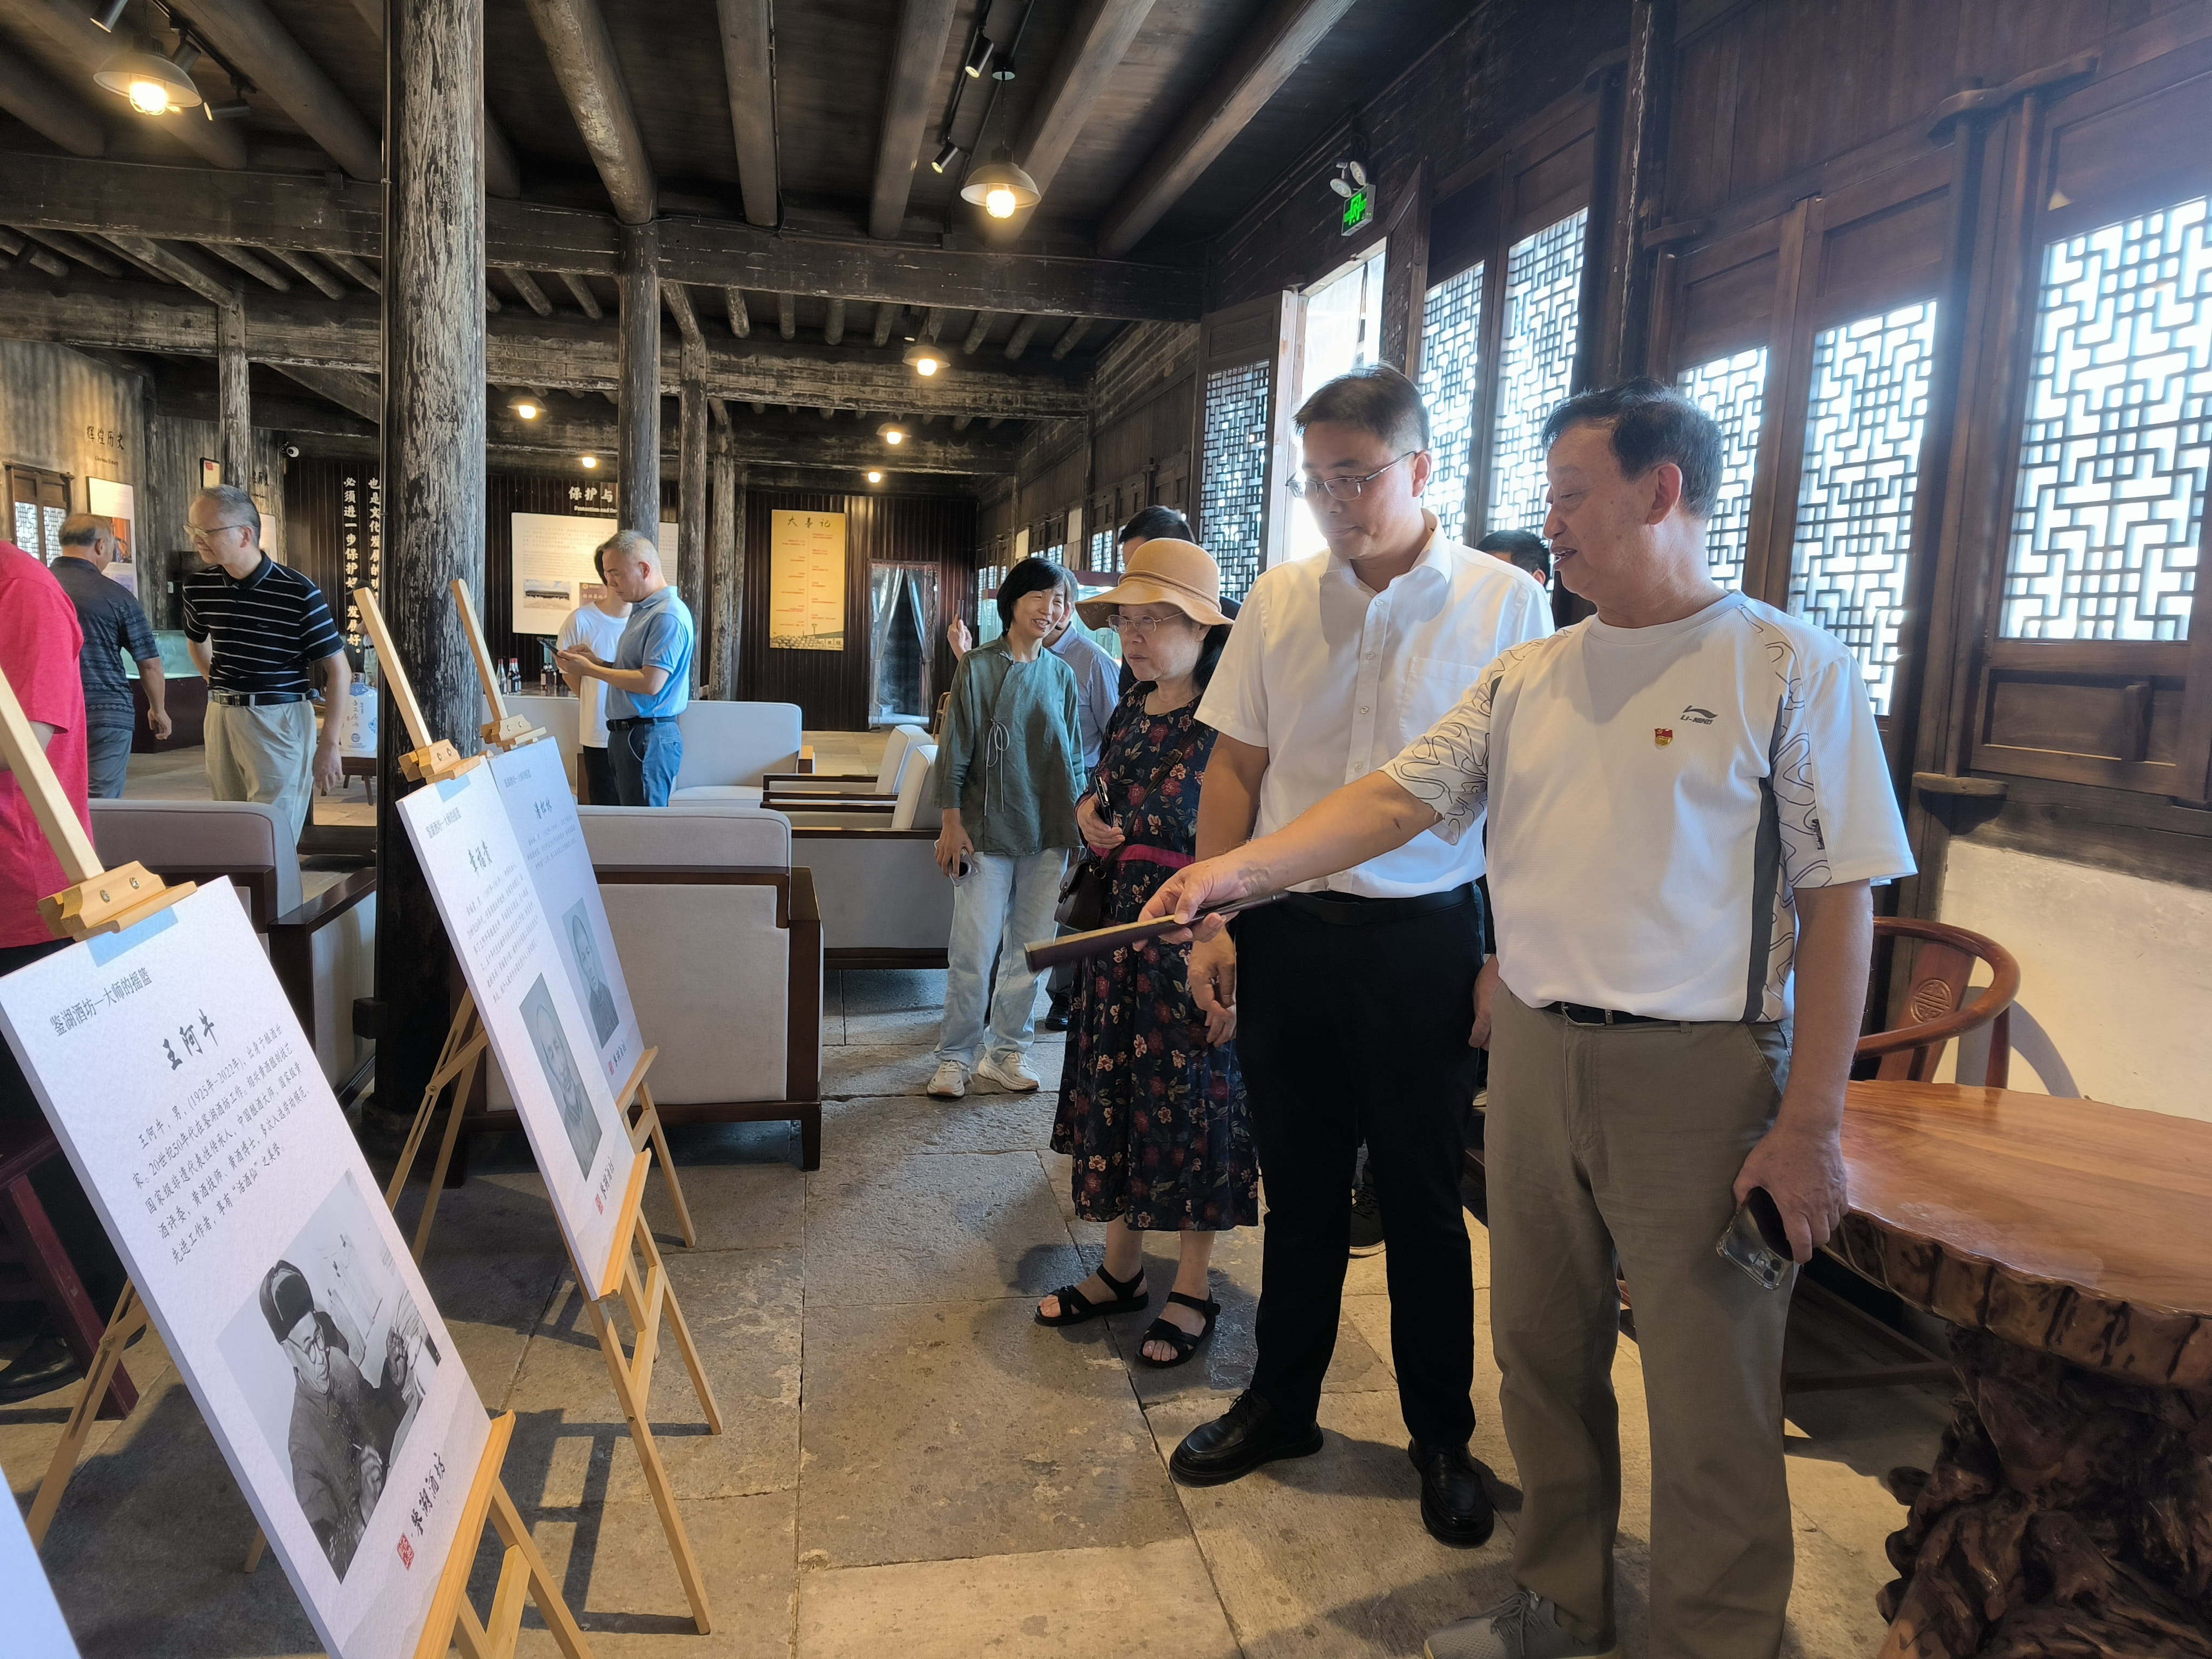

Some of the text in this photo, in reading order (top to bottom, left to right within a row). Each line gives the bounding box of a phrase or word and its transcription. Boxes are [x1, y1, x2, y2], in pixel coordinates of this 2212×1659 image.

[787, 515, 831, 529] 大事记
[163, 1008, 218, 1070] 王阿牛
